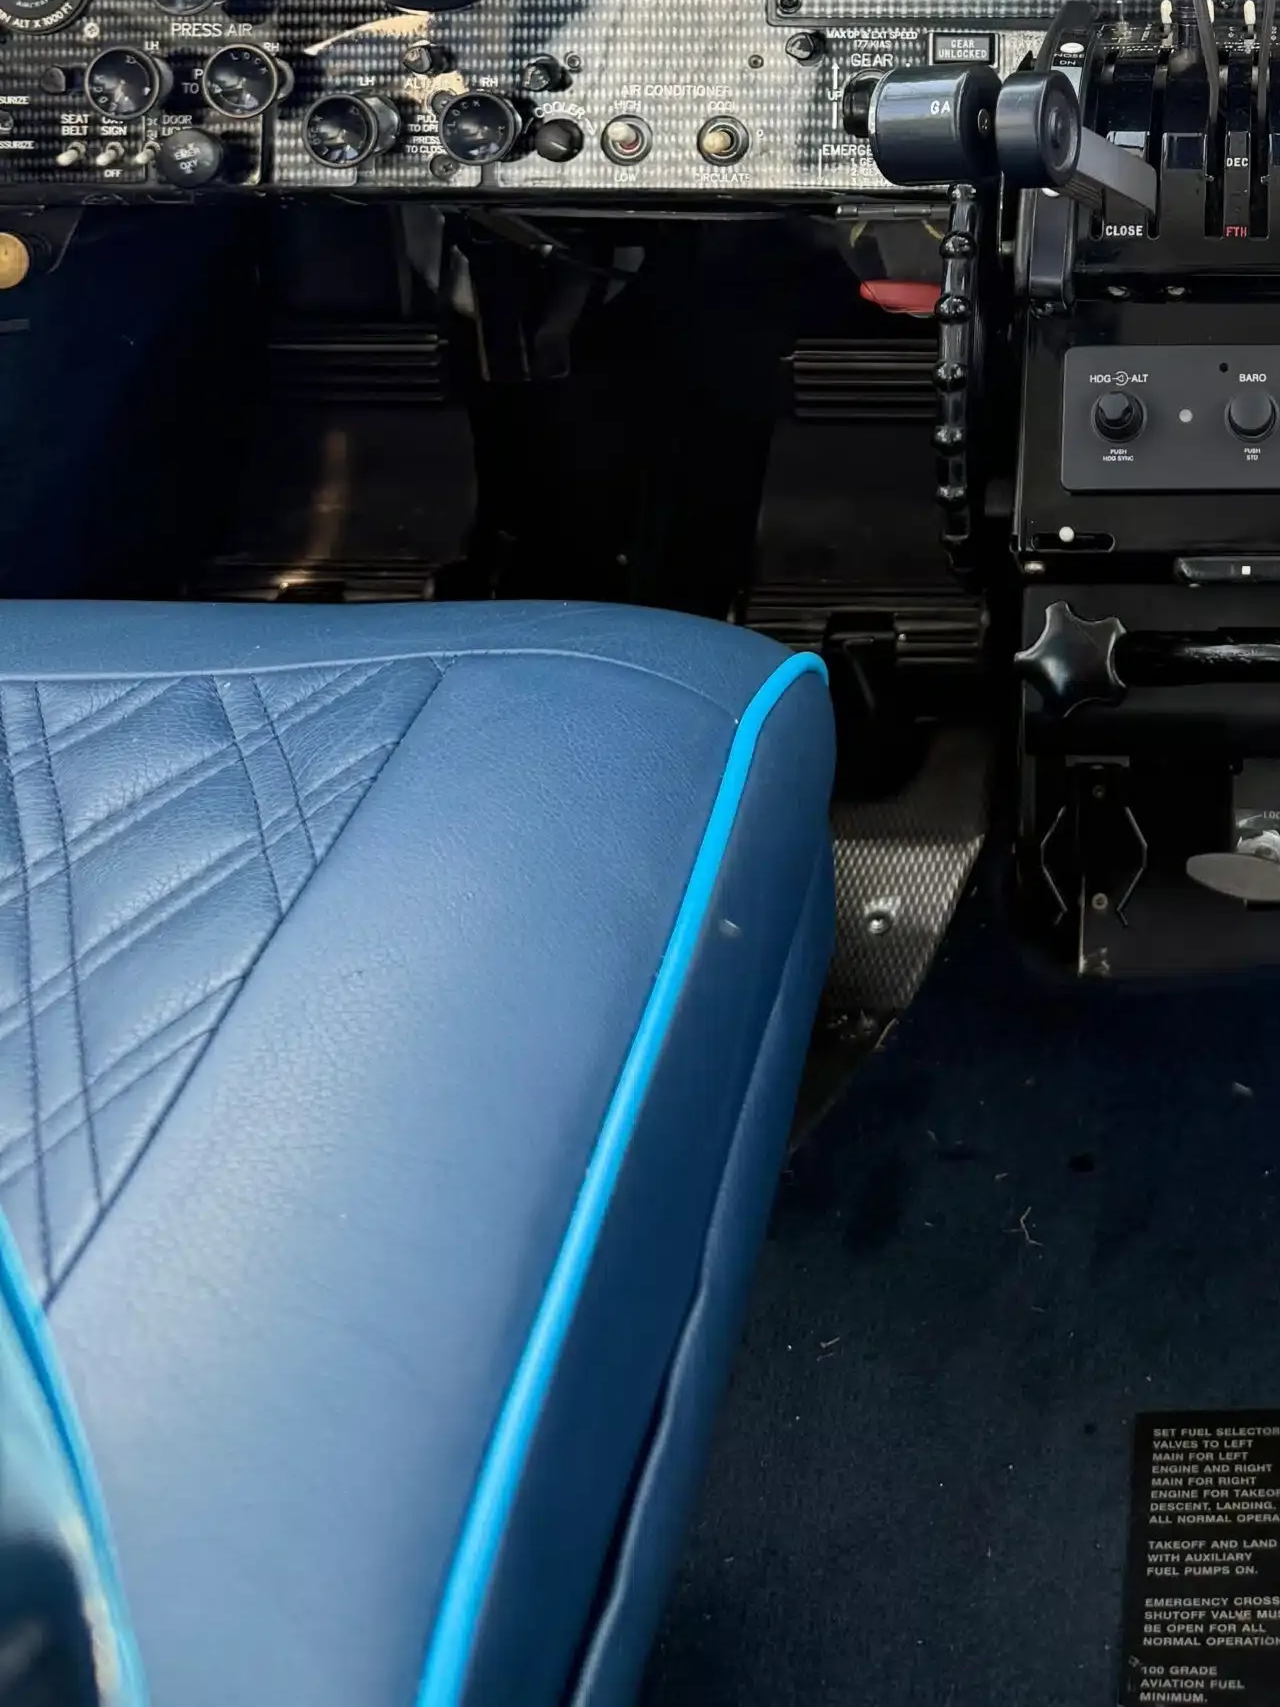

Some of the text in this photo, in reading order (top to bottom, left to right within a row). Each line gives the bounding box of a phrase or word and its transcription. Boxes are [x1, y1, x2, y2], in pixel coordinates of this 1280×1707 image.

[12, 18, 30, 28] ALT
[61, 2, 73, 14] FT
[171, 23, 253, 37] PRESS AIR
[826, 31, 845, 39] MAX
[145, 42, 159, 50] LH
[264, 42, 280, 51] RH
[871, 40, 891, 48] KIAS
[951, 39, 975, 48] GEAR
[938, 49, 987, 58] UNLOCKED
[850, 54, 893, 67] GEAR
[360, 77, 375, 86] LH
[482, 78, 499, 87] RH
[621, 85, 732, 96] AIR CONDITIONER
[828, 90, 843, 100] UP
[534, 101, 586, 118] COOLER
[614, 101, 642, 110] HIGH
[61, 114, 89, 124] SEAT
[162, 115, 192, 124] DOOR
[62, 126, 88, 135] BELT
[101, 126, 127, 136] SIGN
[409, 124, 421, 132] TO
[406, 145, 418, 153] TO
[1226, 157, 1248, 167] DEC
[104, 169, 122, 177] OFF
[614, 173, 637, 182] LOW
[694, 173, 750, 183] CIRCULATE
[1105, 225, 1143, 236] CLOSE
[1226, 226, 1247, 237] FTH
[1090, 374, 1148, 383] HDG ALT
[1239, 374, 1266, 382] BARO
[1181, 1428, 1211, 1436] FUEL
[1216, 1427, 1280, 1435] SELECTOR
[1153, 1439, 1253, 1448] VALVES TO LEFT
[1152, 1452, 1248, 1461] MAIN FOR LEFT
[1152, 1465, 1198, 1473] ENGINE
[1234, 1464, 1272, 1472] RIGHT
[1218, 1477, 1256, 1485] RIGHT
[1151, 1489, 1228, 1498] ENGINE FOR
[1149, 1515, 1172, 1523] ALL
[1177, 1514, 1231, 1523] NORMAL
[1148, 1539, 1277, 1549] TAKEOFF AND LAND
[1147, 1553, 1252, 1562] WITH AUXILIARY
[1147, 1566, 1258, 1576] FUEL PUMPS ON.
[1145, 1598, 1228, 1607] EMERGENCY
[1144, 1611, 1206, 1619] SHUTOFF
[1211, 1611, 1251, 1619] VALVE
[1144, 1624, 1266, 1632] BE OPEN FOR ALL
[1143, 1637, 1200, 1646] NORMAL
[1141, 1666, 1217, 1674] 100 GRADE
[1140, 1679, 1245, 1689] AVIATION FUEL
[1140, 1692, 1208, 1702] MINIMUM.
